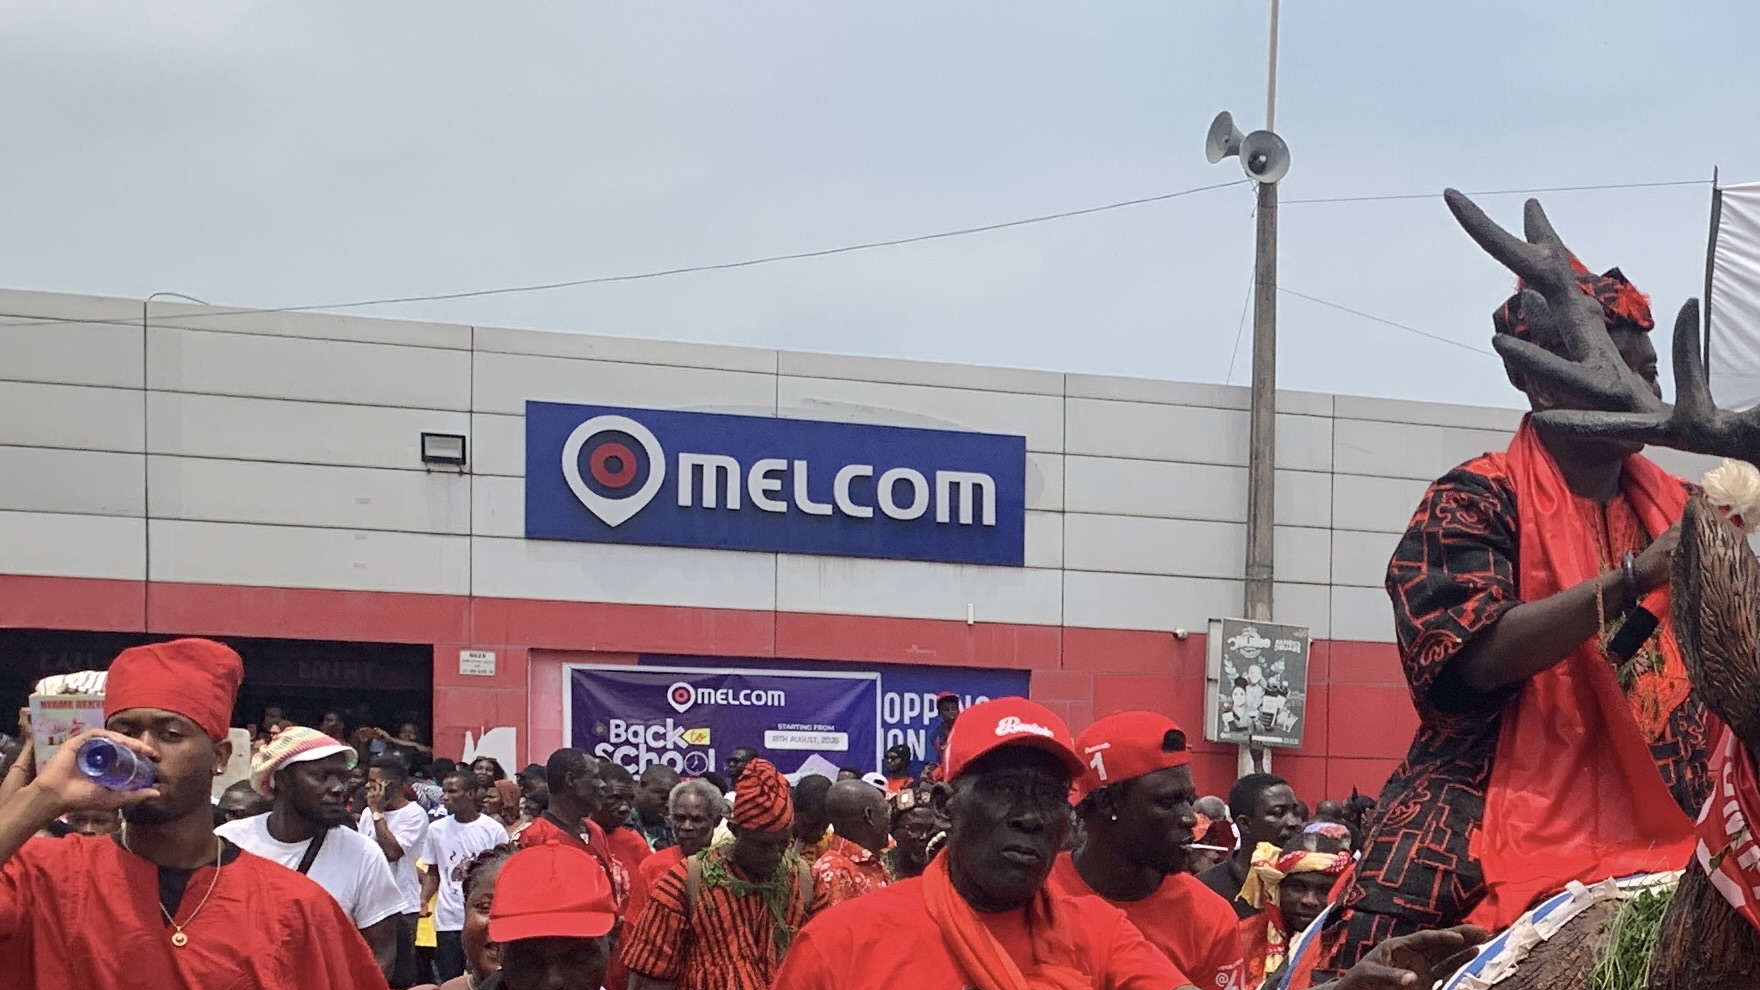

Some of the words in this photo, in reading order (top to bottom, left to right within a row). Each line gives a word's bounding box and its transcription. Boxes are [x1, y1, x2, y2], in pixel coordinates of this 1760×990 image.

[677, 452, 997, 527] MELCOM
[697, 688, 786, 707] MELCOM
[609, 718, 689, 750] Back
[689, 730, 708, 743] to
[777, 723, 813, 731] STARTING
[813, 723, 835, 731] FROM
